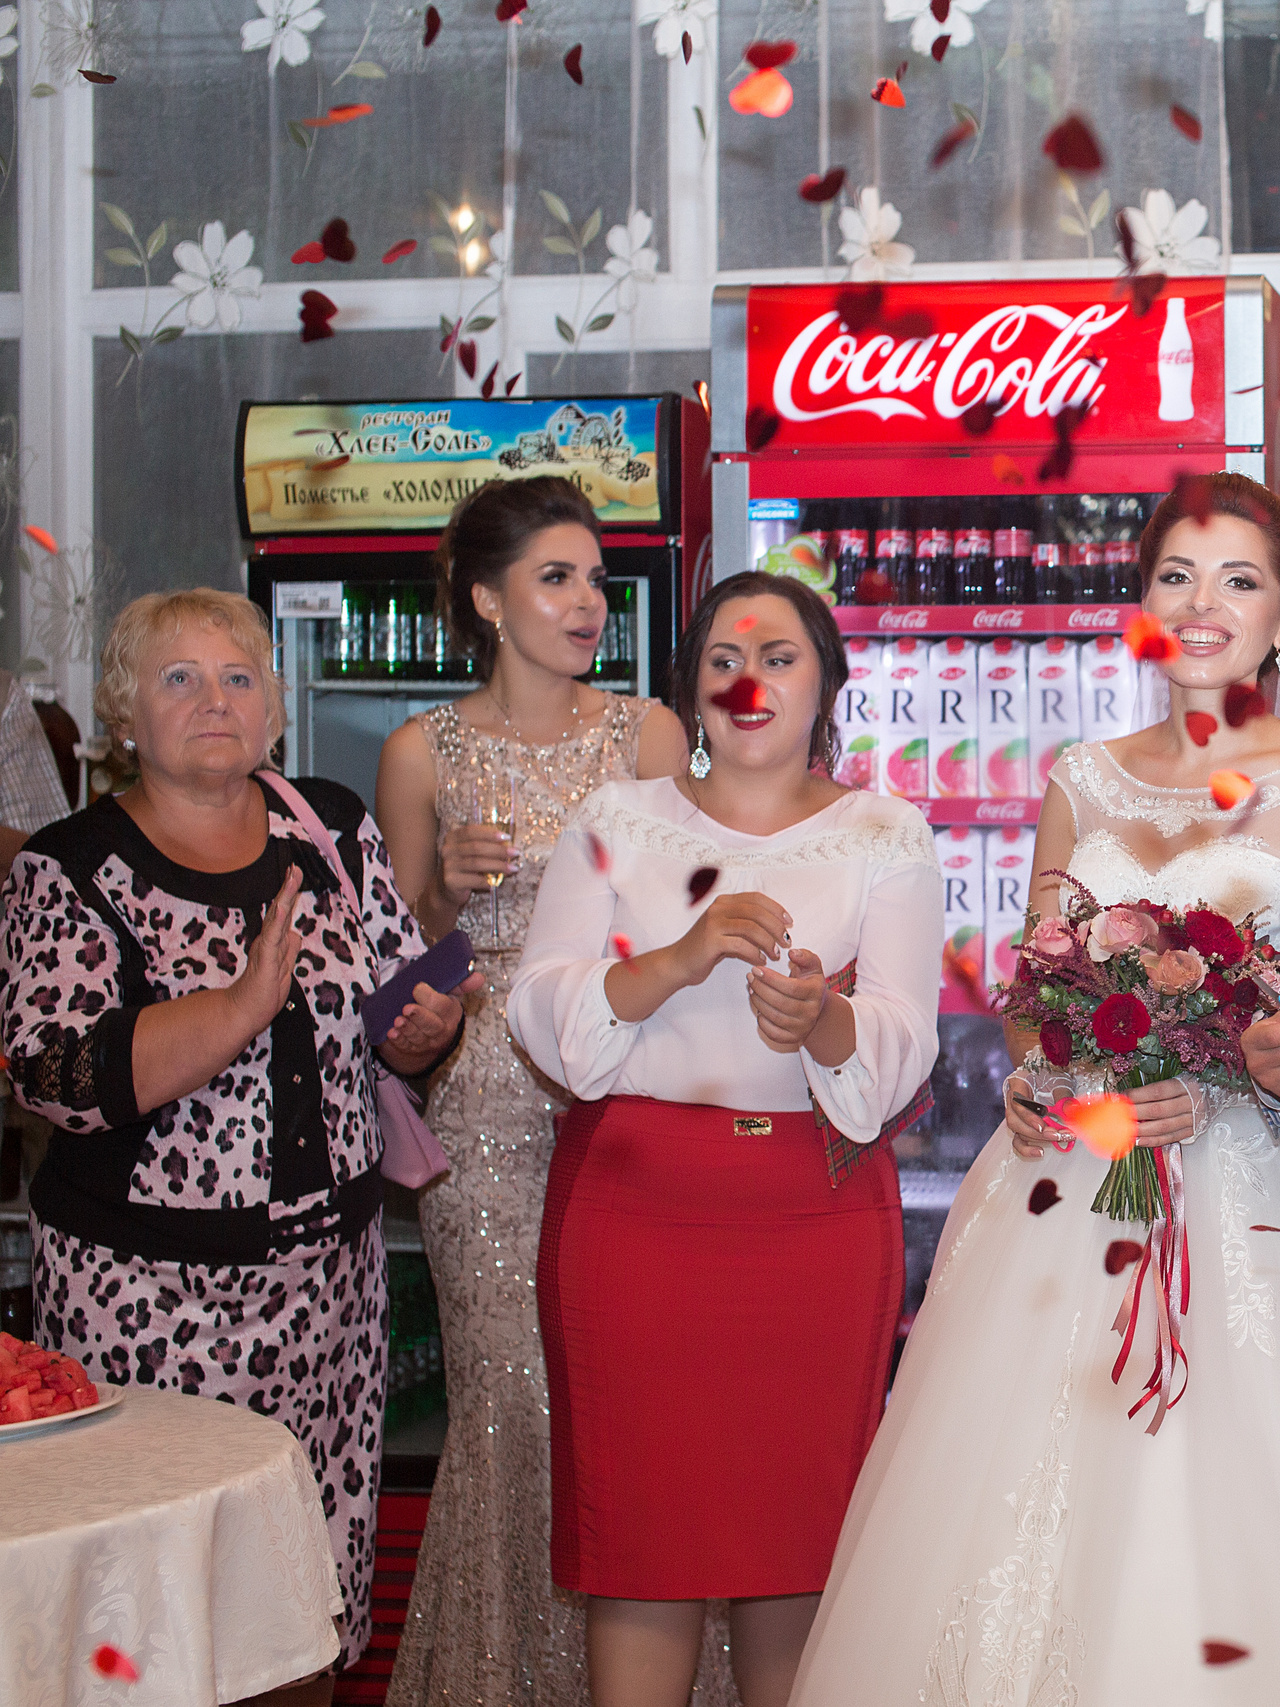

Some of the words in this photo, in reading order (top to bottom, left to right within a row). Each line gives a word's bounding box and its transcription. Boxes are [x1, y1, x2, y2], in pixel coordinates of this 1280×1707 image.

[773, 303, 1129, 422] Coca-Cola
[383, 473, 500, 503] «ХОЛОДН
[973, 609, 1023, 627] Coca-Cola
[1068, 608, 1119, 627] Coca-Cola
[846, 689, 869, 723] R
[892, 689, 916, 723] R
[940, 689, 965, 723] R
[989, 689, 1016, 723] R
[1040, 688, 1067, 723] R
[1094, 688, 1119, 722] R
[945, 878, 970, 912] R
[998, 878, 1023, 912] R
